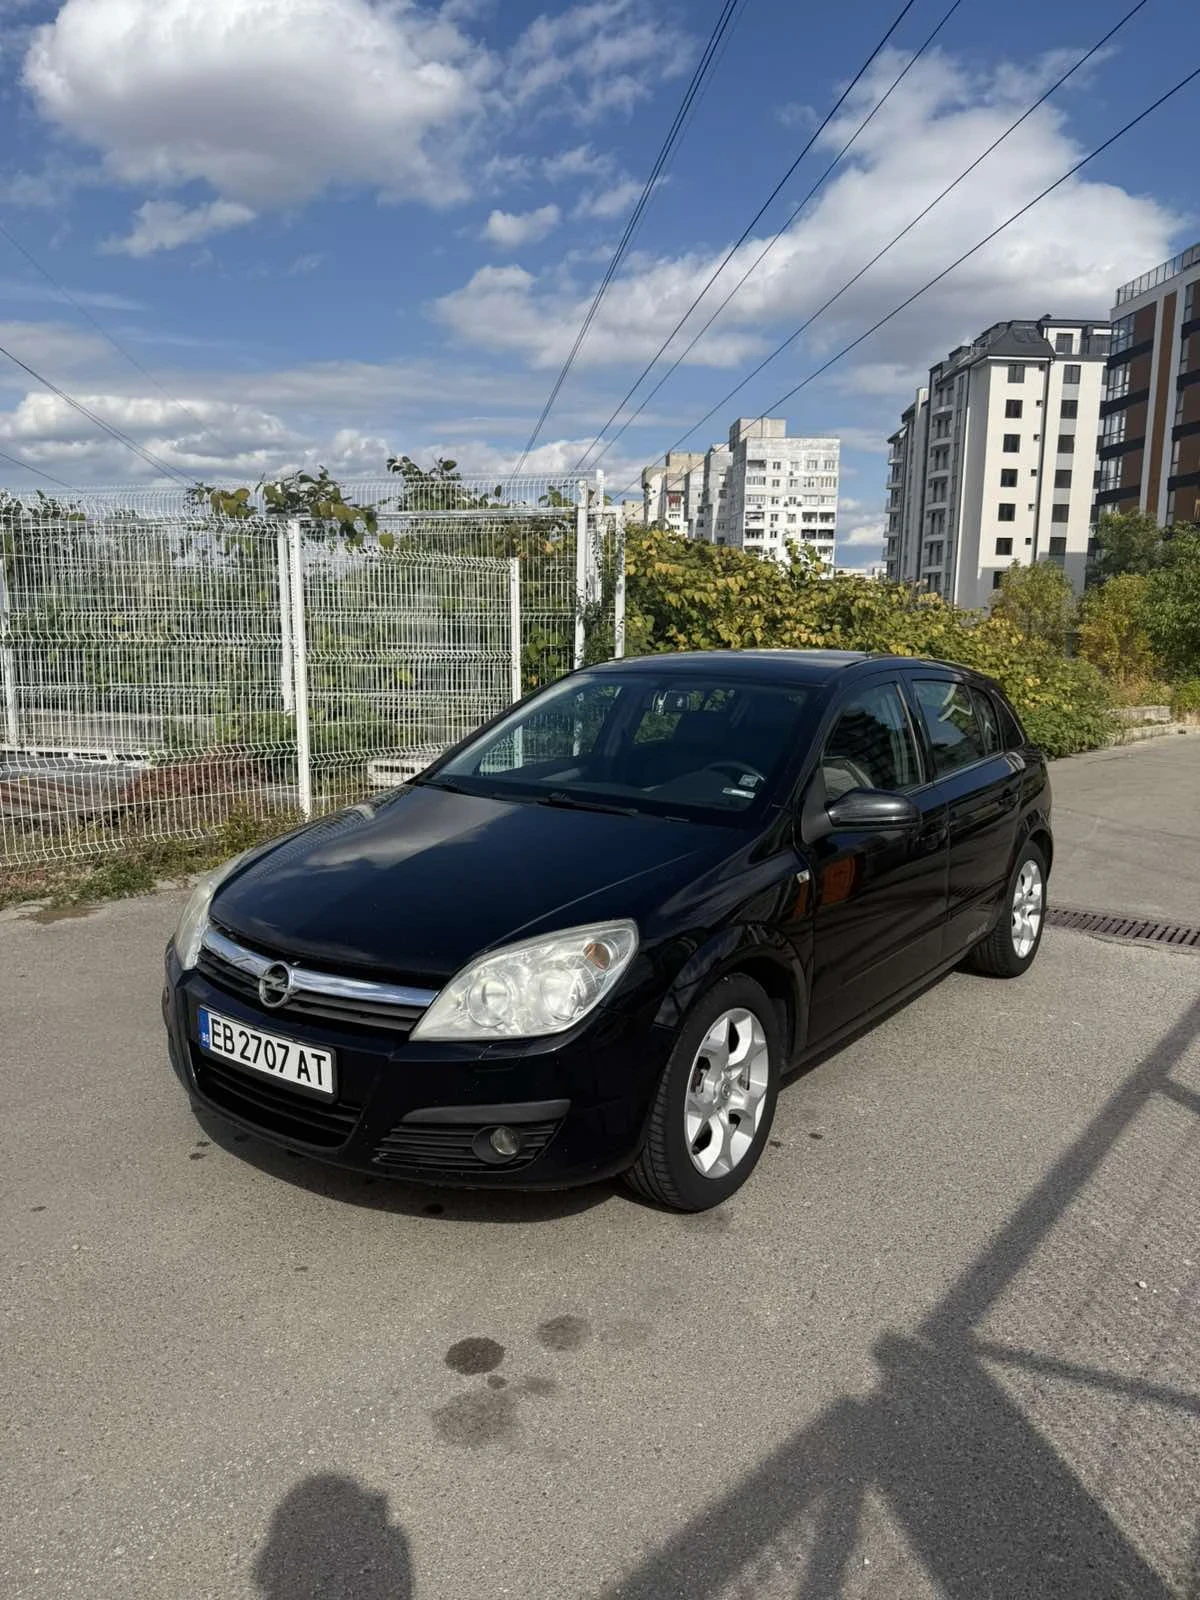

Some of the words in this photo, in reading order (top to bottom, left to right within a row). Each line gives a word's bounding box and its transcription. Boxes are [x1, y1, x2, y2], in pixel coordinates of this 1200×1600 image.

[210, 1017, 235, 1054] EB
[239, 1030, 290, 1074] 2707
[297, 1050, 327, 1086] AT
